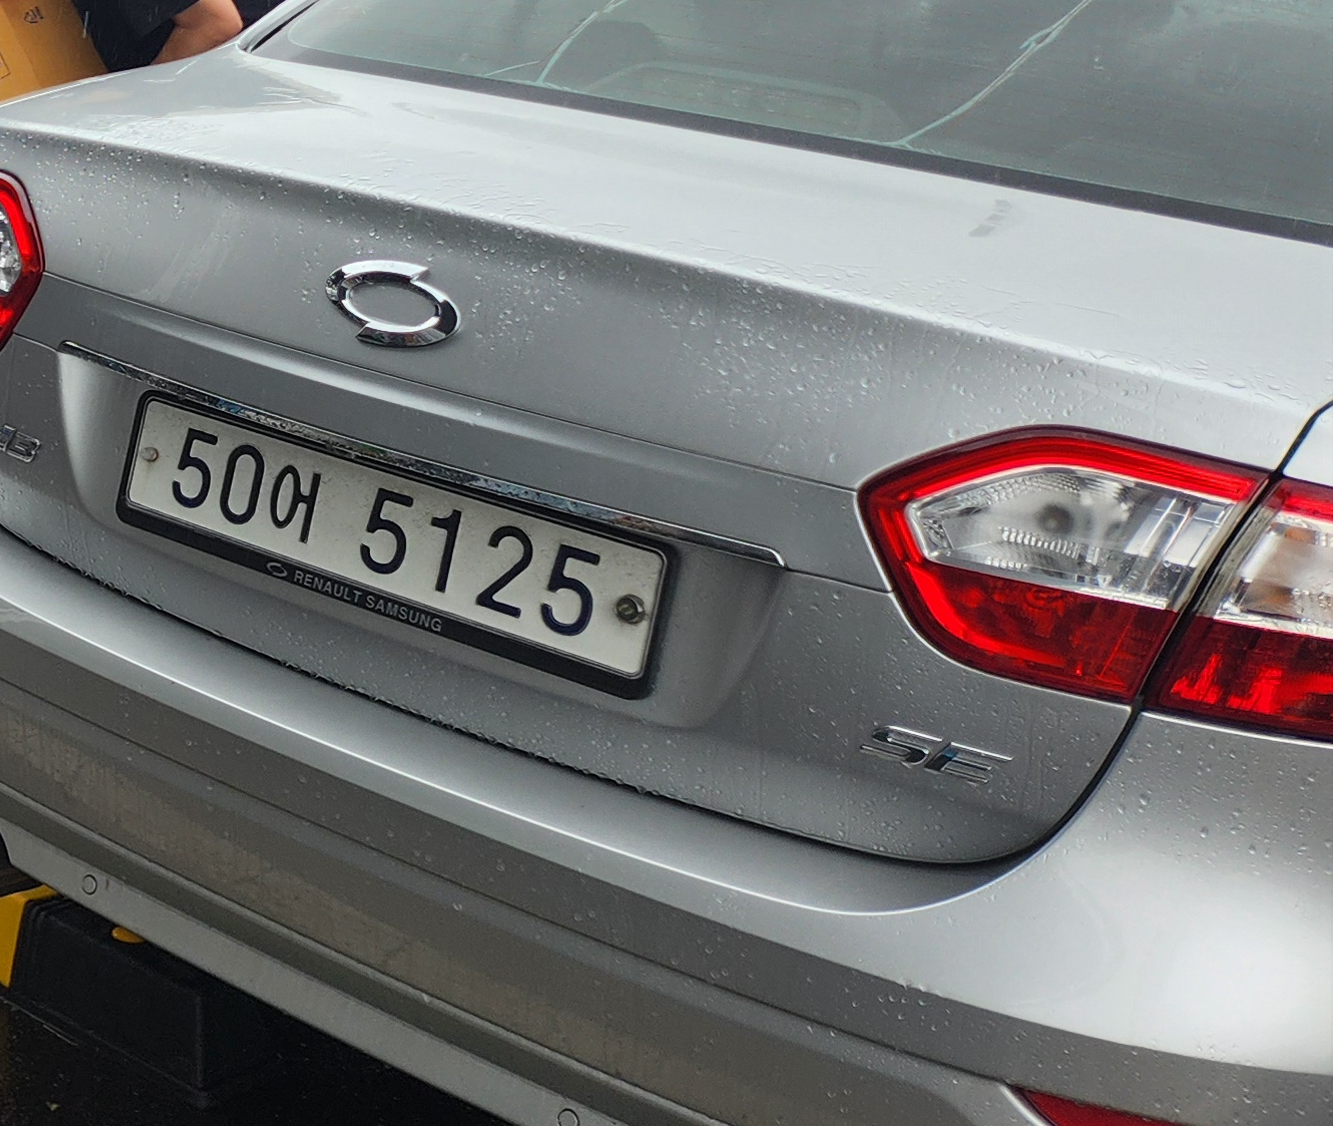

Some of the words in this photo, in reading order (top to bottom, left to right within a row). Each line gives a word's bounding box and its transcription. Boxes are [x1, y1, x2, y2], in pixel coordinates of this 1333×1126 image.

[171, 427, 322, 545] 50어
[359, 487, 601, 637] 5125
[292, 569, 364, 604] RENAULT
[365, 594, 443, 633] SAMSUNG
